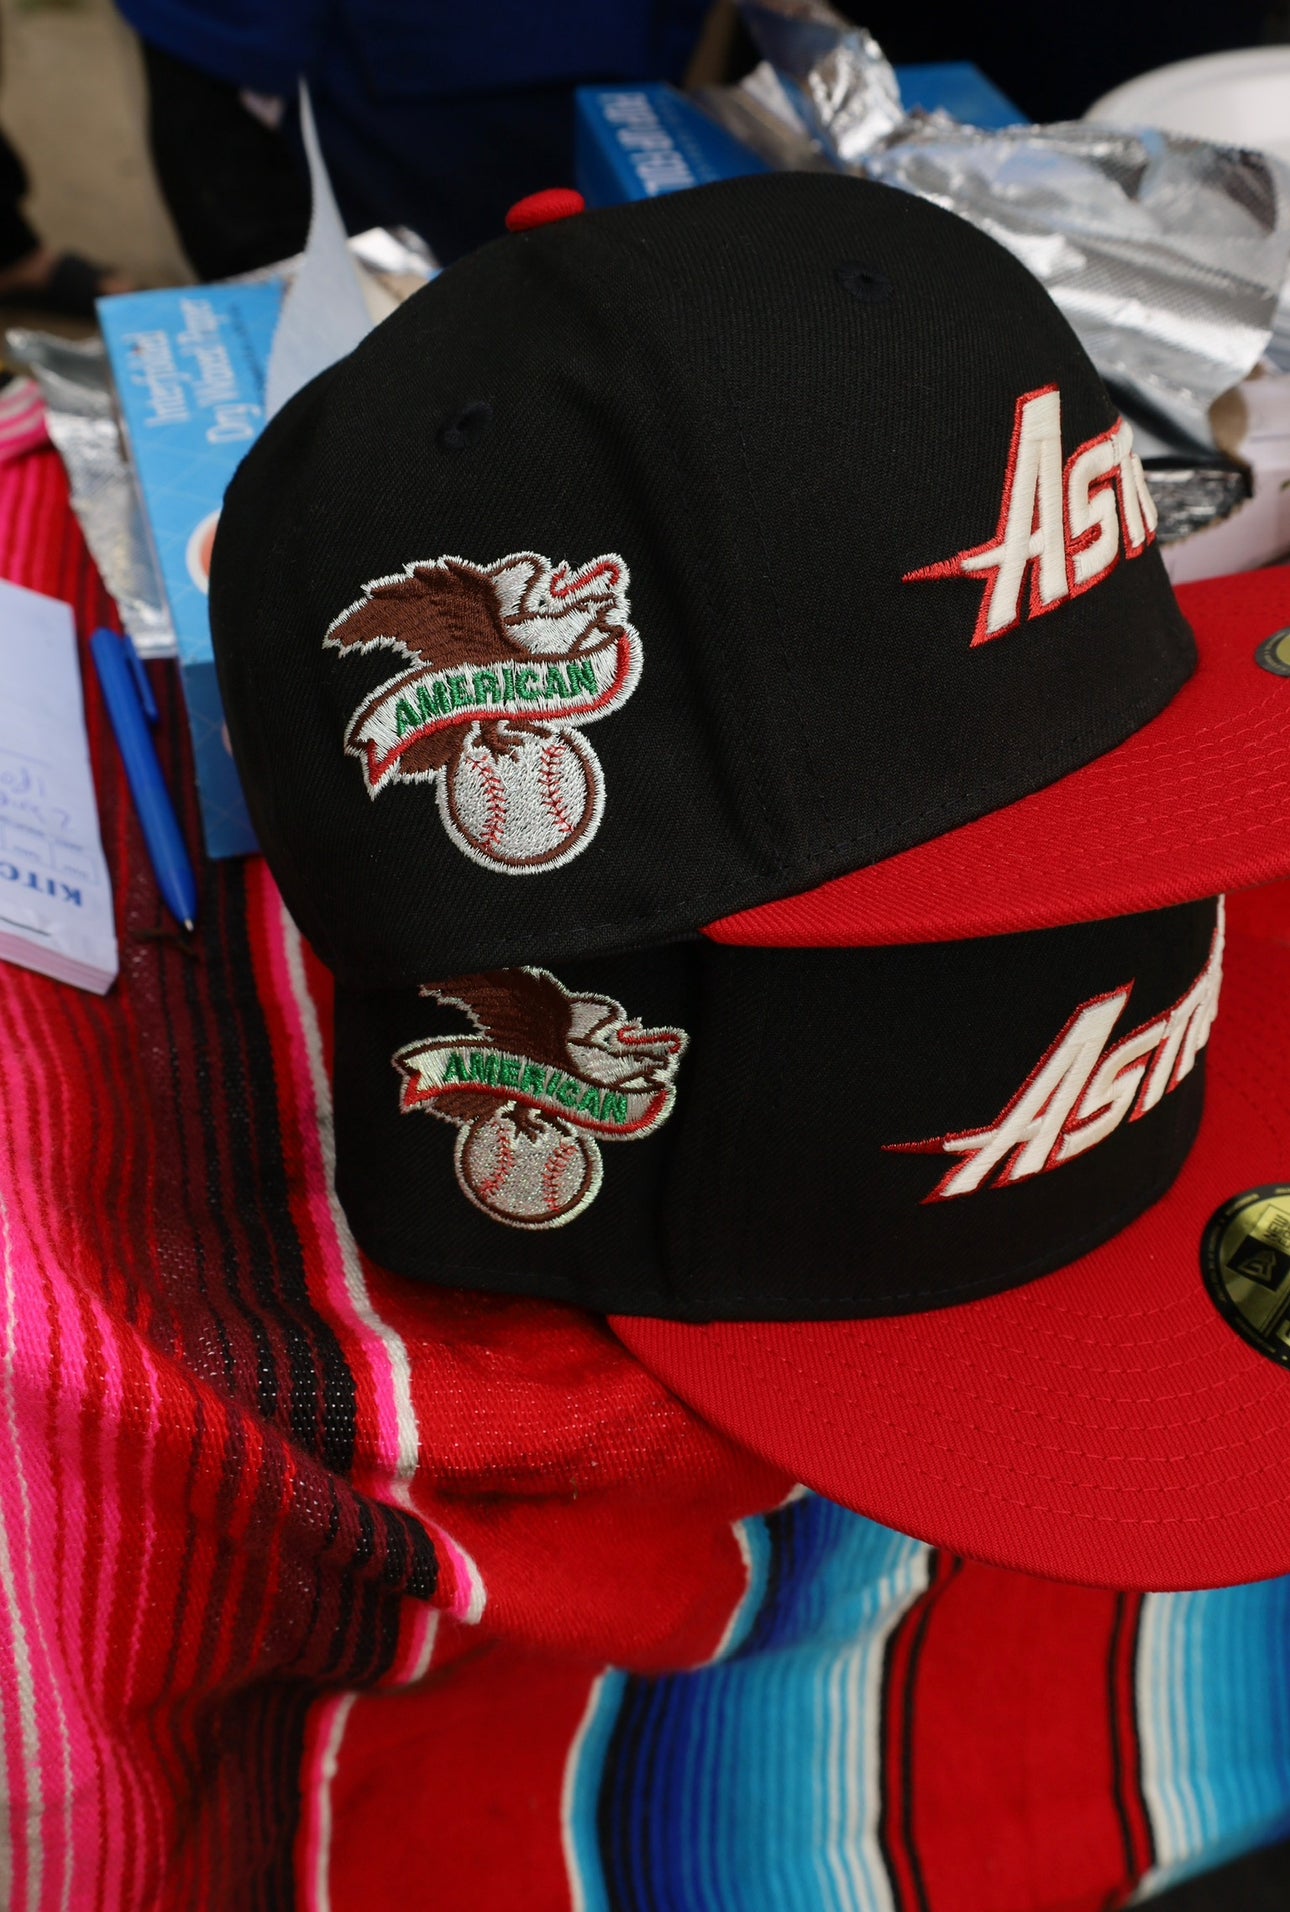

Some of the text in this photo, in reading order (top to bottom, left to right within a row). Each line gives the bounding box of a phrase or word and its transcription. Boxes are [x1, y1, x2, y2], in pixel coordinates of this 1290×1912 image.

[206, 402, 261, 444] Dry
[395, 660, 599, 737] AMERICAN
[444, 1051, 628, 1125] AMERICAN
[1263, 1213, 1289, 1243] NEW
